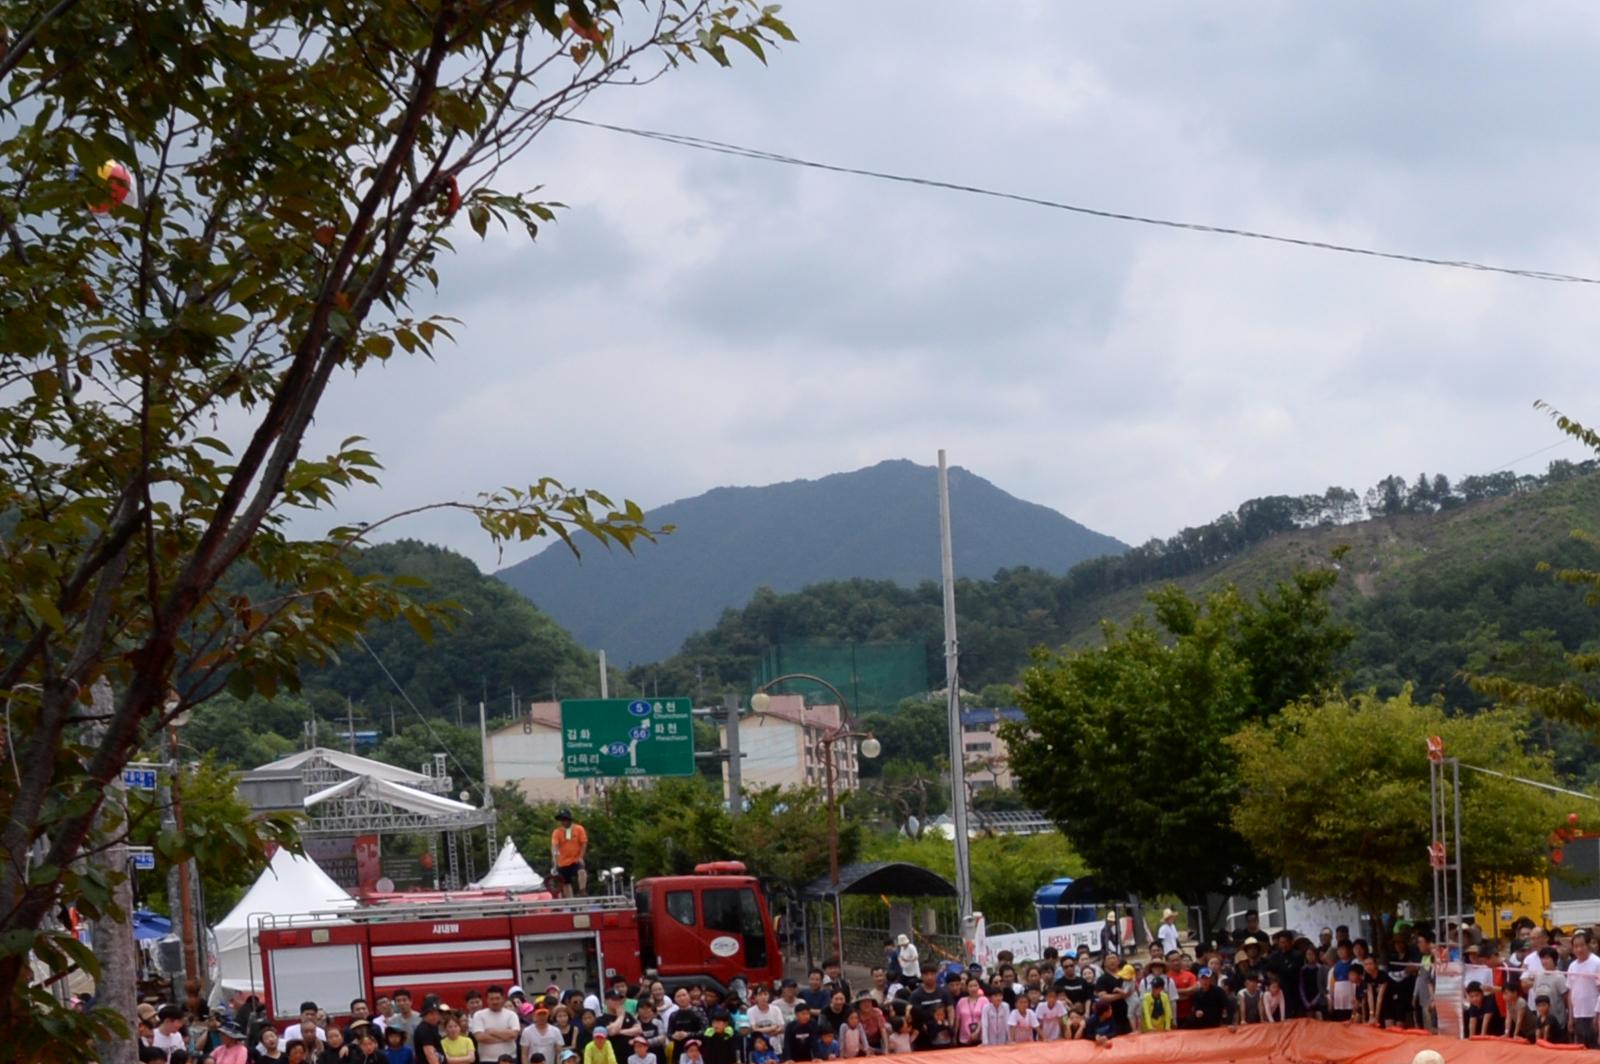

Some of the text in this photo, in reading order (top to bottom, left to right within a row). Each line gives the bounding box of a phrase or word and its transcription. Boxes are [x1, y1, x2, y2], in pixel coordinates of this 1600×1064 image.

[523, 720, 533, 735] 6
[633, 729, 647, 738] 56
[611, 745, 625, 754] 56
